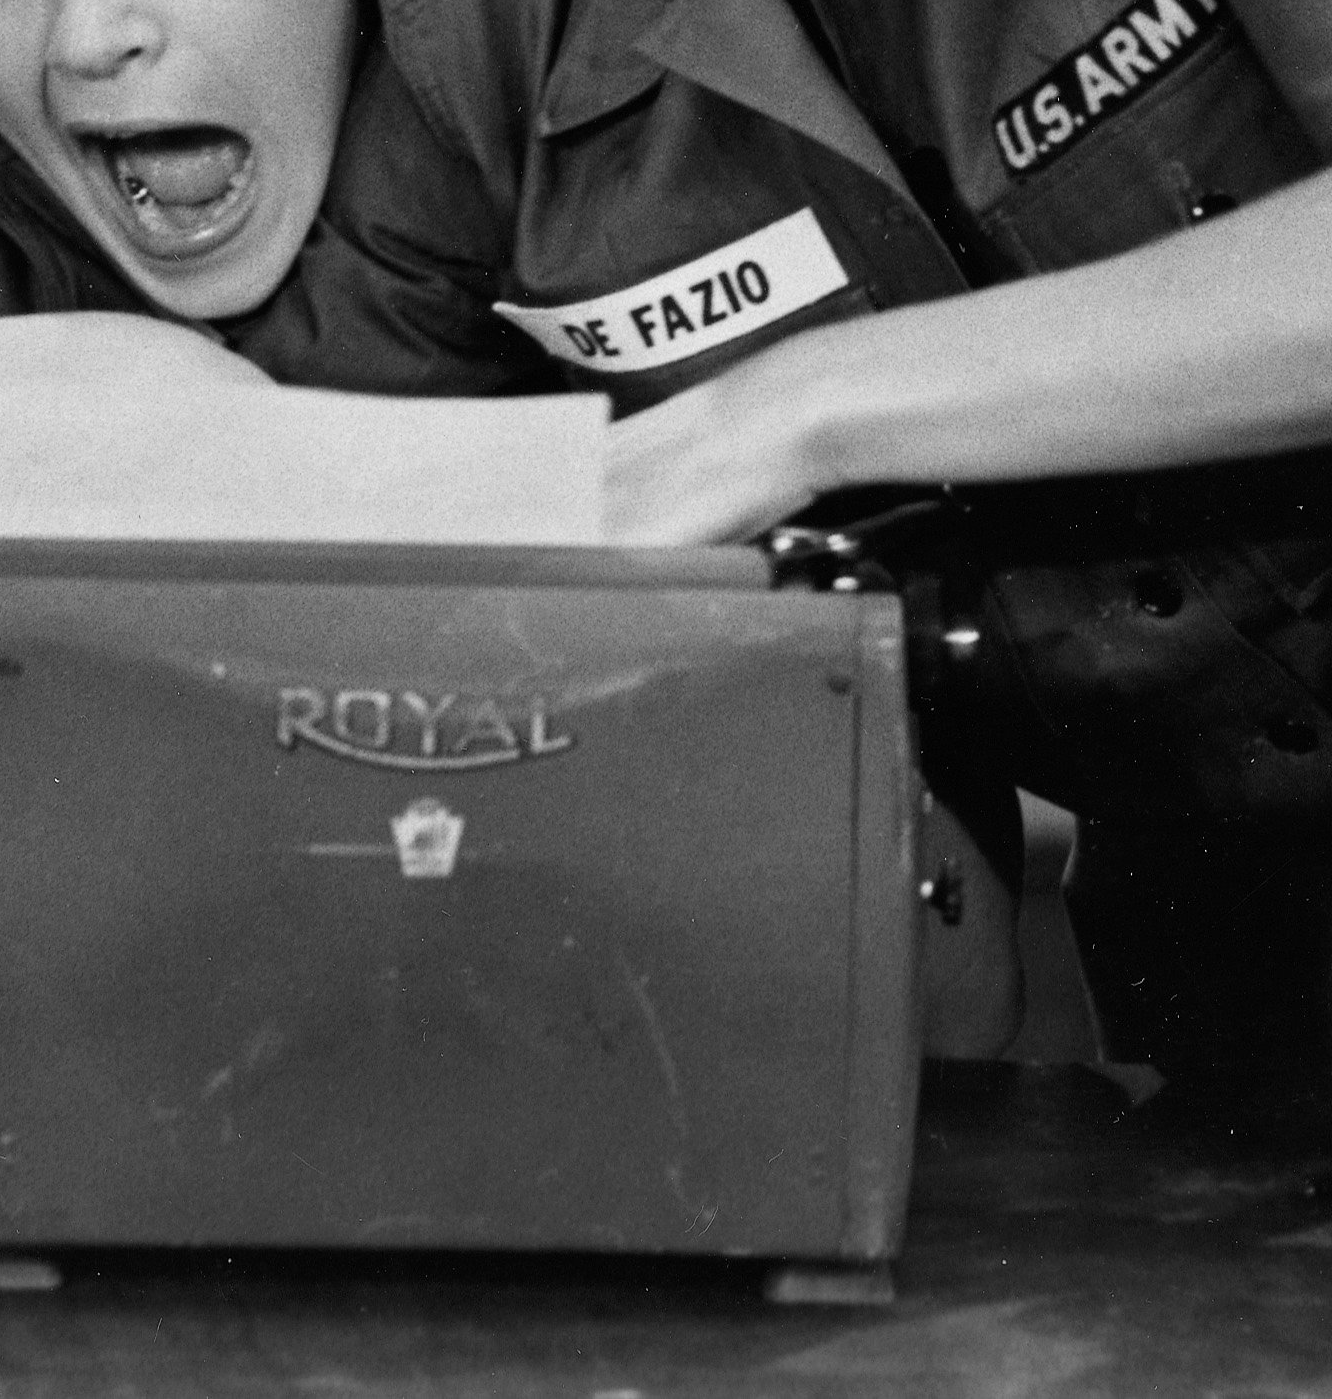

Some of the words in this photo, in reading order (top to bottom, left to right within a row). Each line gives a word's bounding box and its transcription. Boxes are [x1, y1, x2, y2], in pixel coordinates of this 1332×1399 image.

[996, 82, 1085, 169] U.S.
[563, 319, 619, 357] DE
[629, 260, 770, 349] FAZIO
[277, 687, 571, 769] ROYAL
